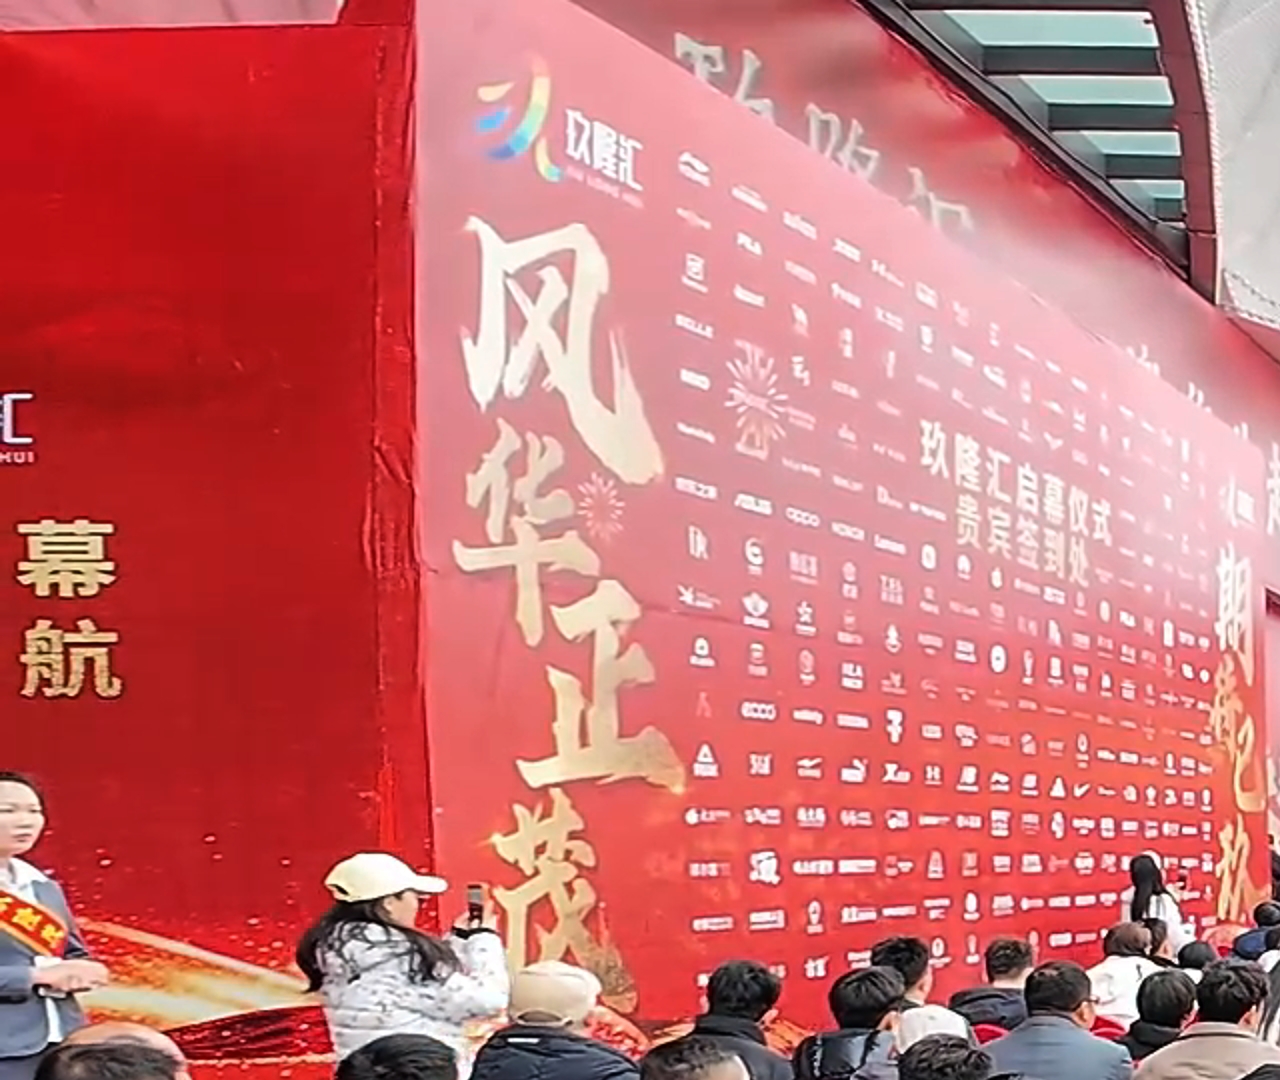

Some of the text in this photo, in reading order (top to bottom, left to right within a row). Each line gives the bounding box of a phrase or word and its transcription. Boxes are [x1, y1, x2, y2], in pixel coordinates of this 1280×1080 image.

[565, 108, 643, 191] 玖隆汇
[920, 418, 1112, 547] 玖隆汇启幕仪式
[17, 519, 116, 597] 幕
[956, 493, 1089, 588] 贵宾签到处
[20, 618, 122, 697] 航
[452, 214, 687, 1014] 风华正茂
